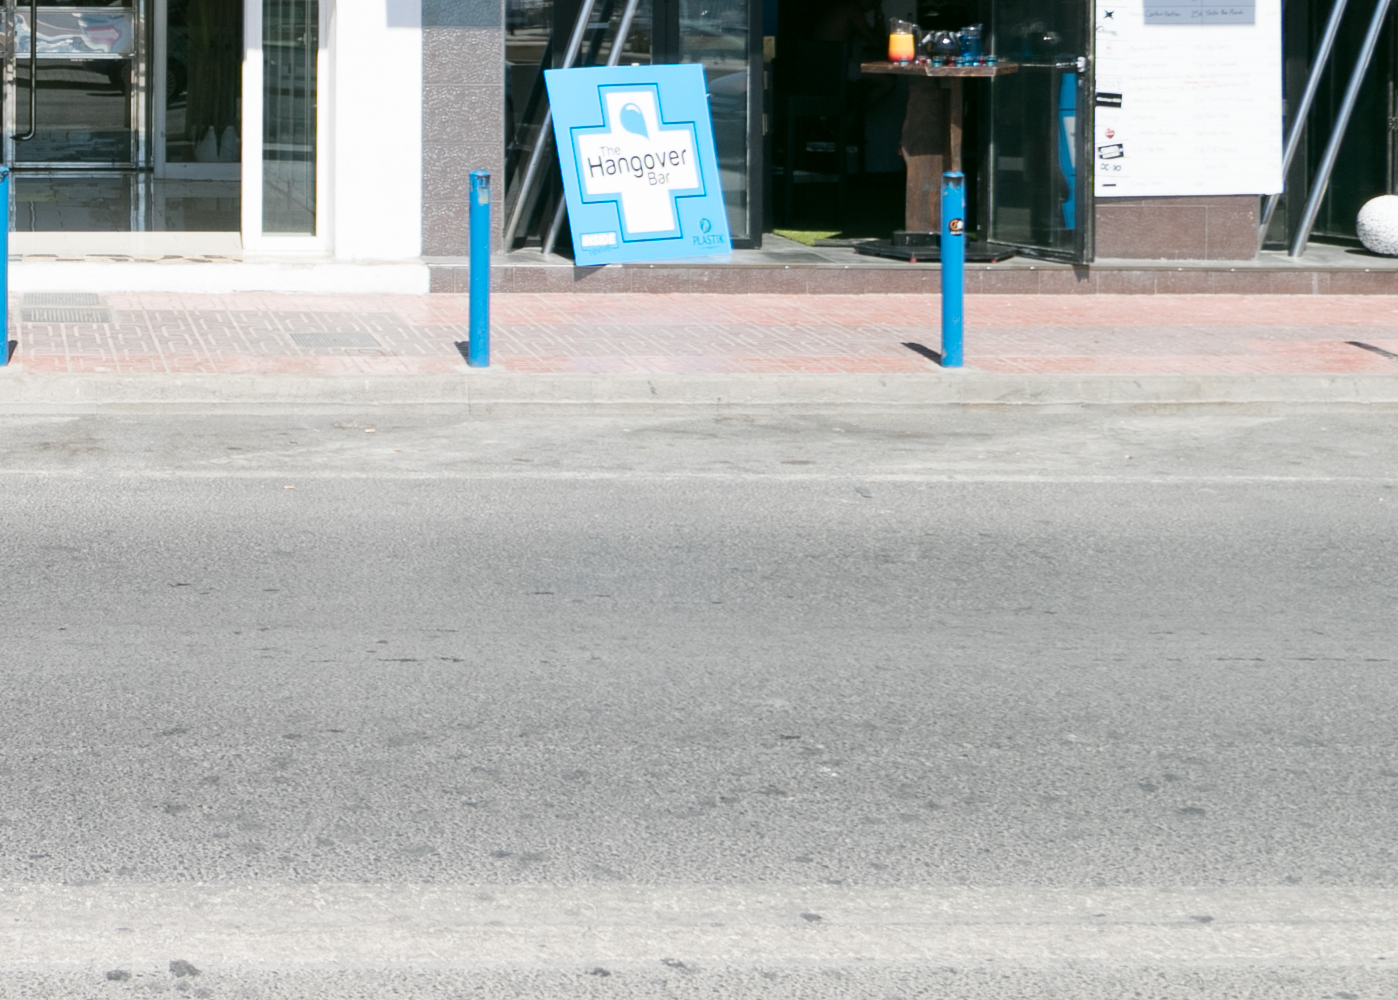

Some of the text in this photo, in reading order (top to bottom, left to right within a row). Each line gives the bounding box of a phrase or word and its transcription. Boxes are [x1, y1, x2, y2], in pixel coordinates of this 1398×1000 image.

[600, 145, 621, 157] The
[587, 149, 687, 178] Hangover
[647, 171, 670, 186] Bar
[581, 232, 616, 247] INSIDE
[692, 234, 725, 246] PLASTIK
